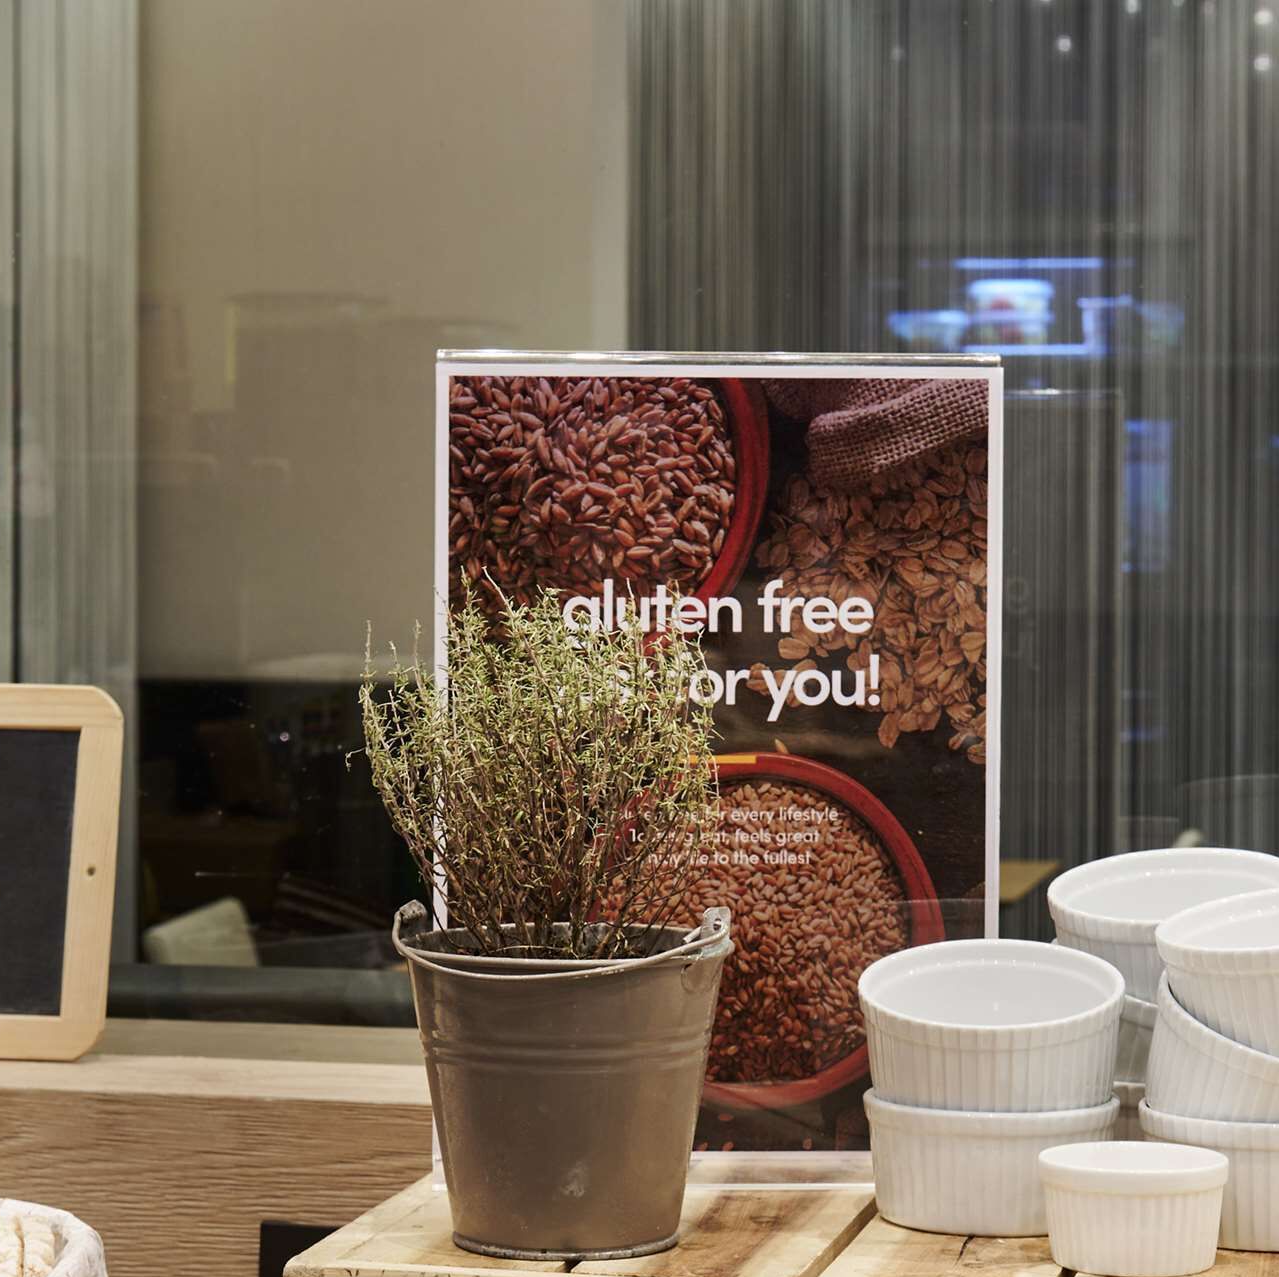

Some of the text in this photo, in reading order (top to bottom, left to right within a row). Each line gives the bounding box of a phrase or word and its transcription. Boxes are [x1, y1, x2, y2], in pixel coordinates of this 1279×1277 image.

[562, 578, 874, 650] gluten free
[677, 652, 749, 706] or
[762, 654, 881, 722] you!
[731, 809, 774, 823] every
[779, 806, 839, 824] lifestyle
[735, 828, 771, 843] feels
[775, 830, 820, 847] great
[733, 849, 759, 865] the
[763, 849, 811, 865] fullest
